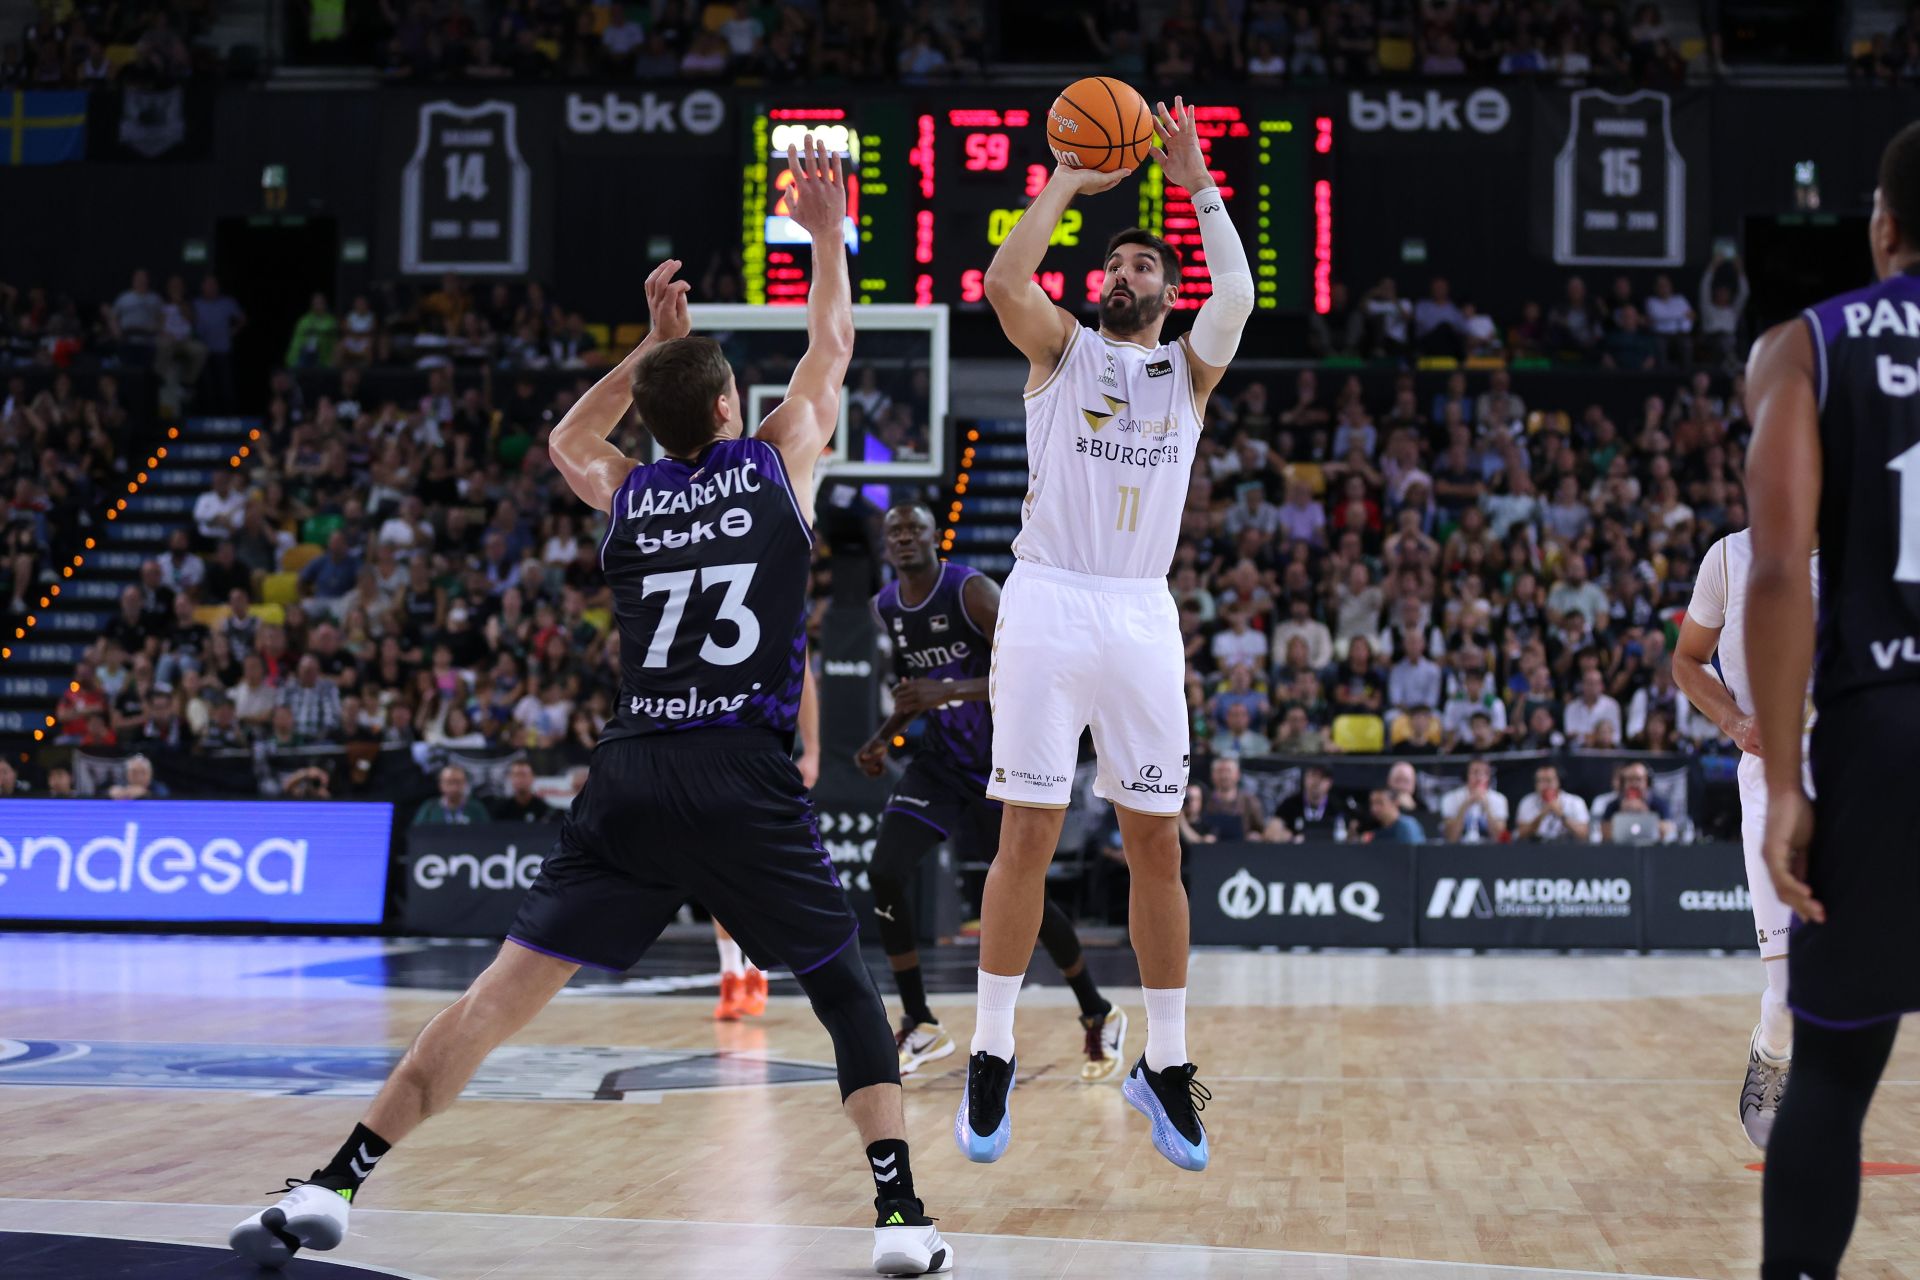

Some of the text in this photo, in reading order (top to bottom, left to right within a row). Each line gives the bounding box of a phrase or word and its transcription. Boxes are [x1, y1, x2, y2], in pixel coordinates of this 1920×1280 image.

[566, 92, 676, 133] bbk
[1349, 89, 1461, 131] bbk
[964, 132, 1010, 171] 59
[1599, 148, 1642, 197] 15
[443, 152, 489, 201] 14
[1876, 354, 1920, 397] b
[627, 458, 761, 520] LAZAREVIĆ
[1115, 485, 1141, 533] 11
[635, 520, 717, 554] bbk
[641, 562, 761, 668] 73
[1011, 770, 1042, 781] CASTILLA
[1121, 780, 1179, 794] LEXUS
[1267, 881, 1385, 923] IMQ
[1494, 878, 1632, 903] MEDRANO
